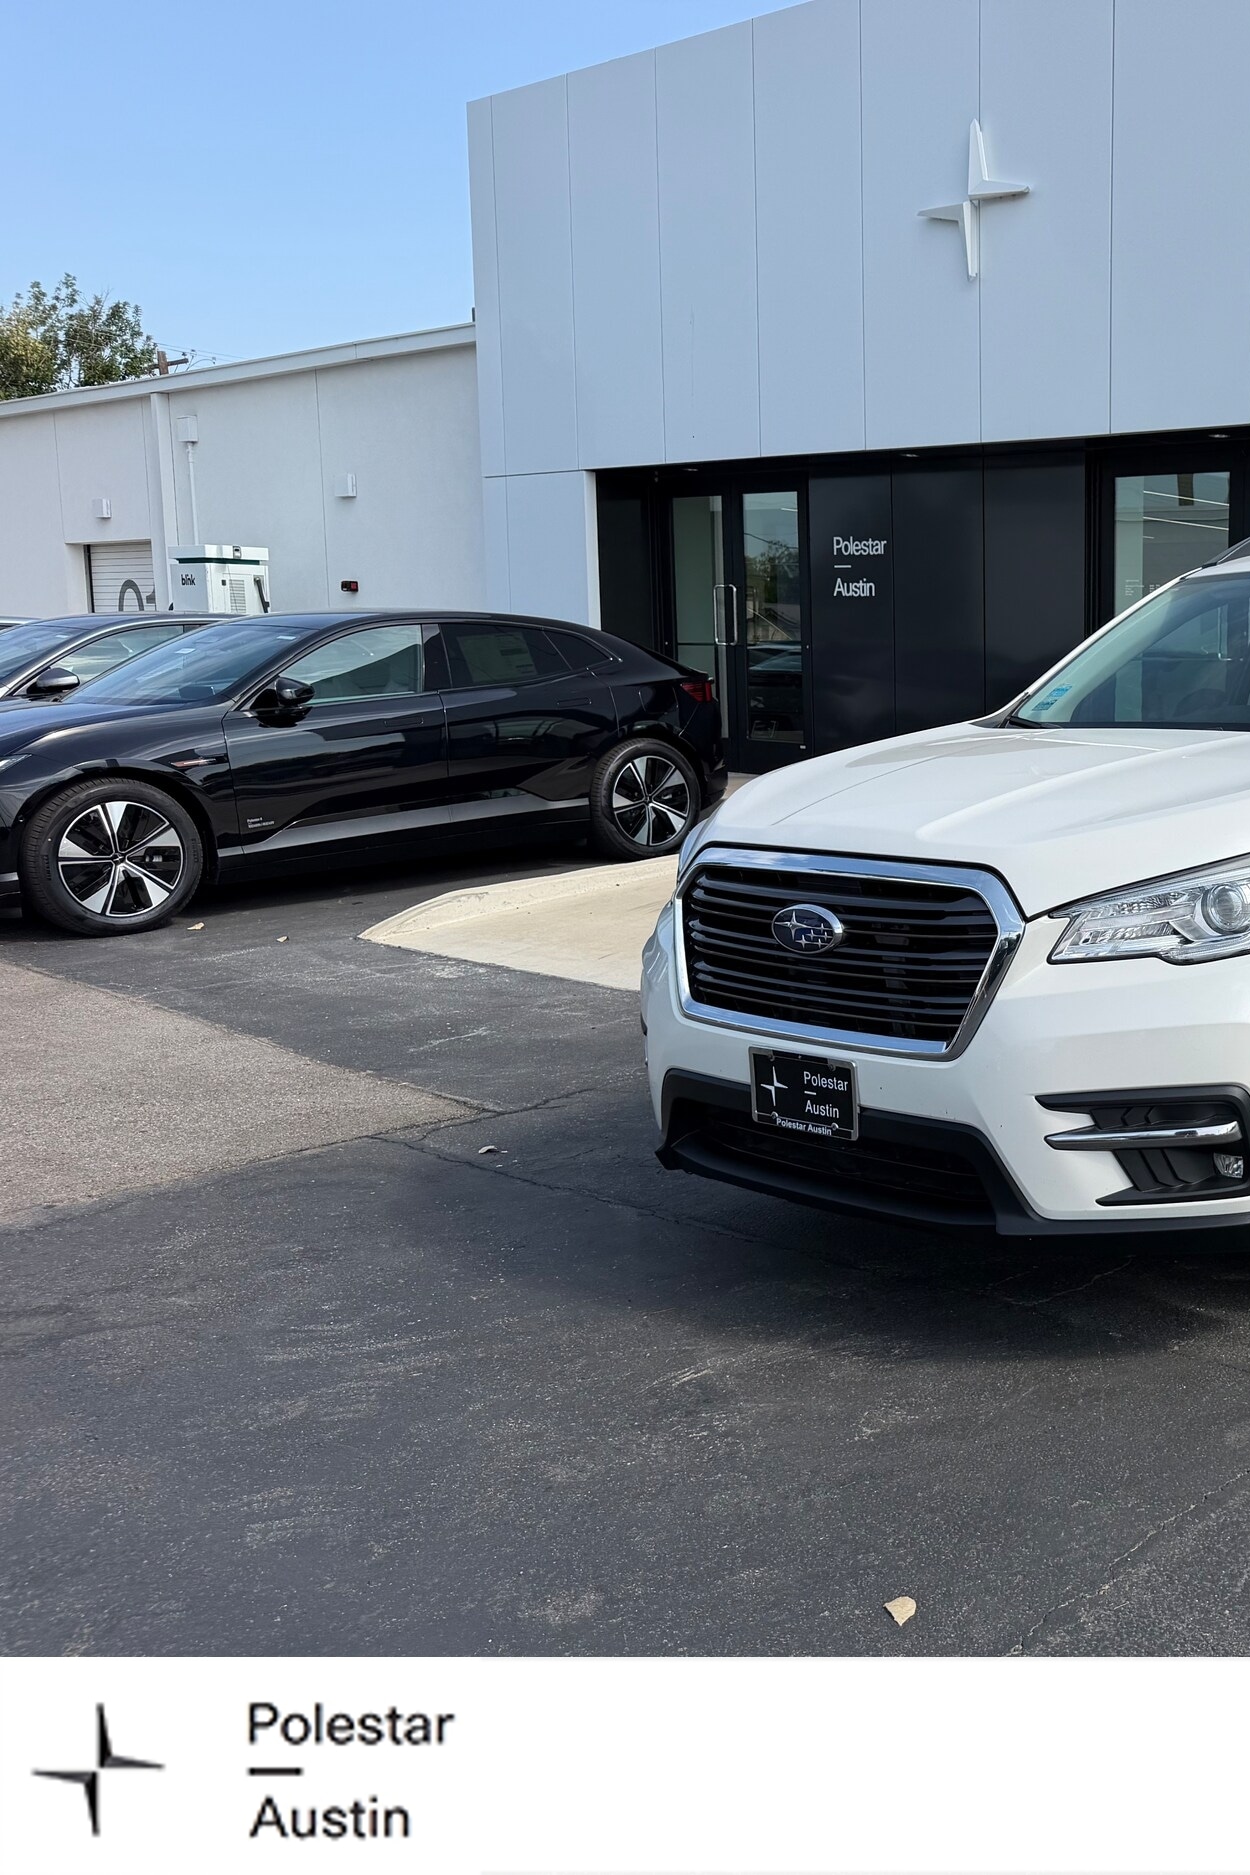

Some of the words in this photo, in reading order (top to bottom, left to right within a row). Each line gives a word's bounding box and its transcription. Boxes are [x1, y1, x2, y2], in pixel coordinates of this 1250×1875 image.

[833, 536, 887, 556] Polestar
[181, 574, 196, 586] blink
[833, 577, 876, 597] Austin
[803, 1071, 848, 1092] Polestar
[805, 1099, 840, 1119] Austin
[776, 1118, 806, 1131] Polestar
[807, 1123, 832, 1136] Austin
